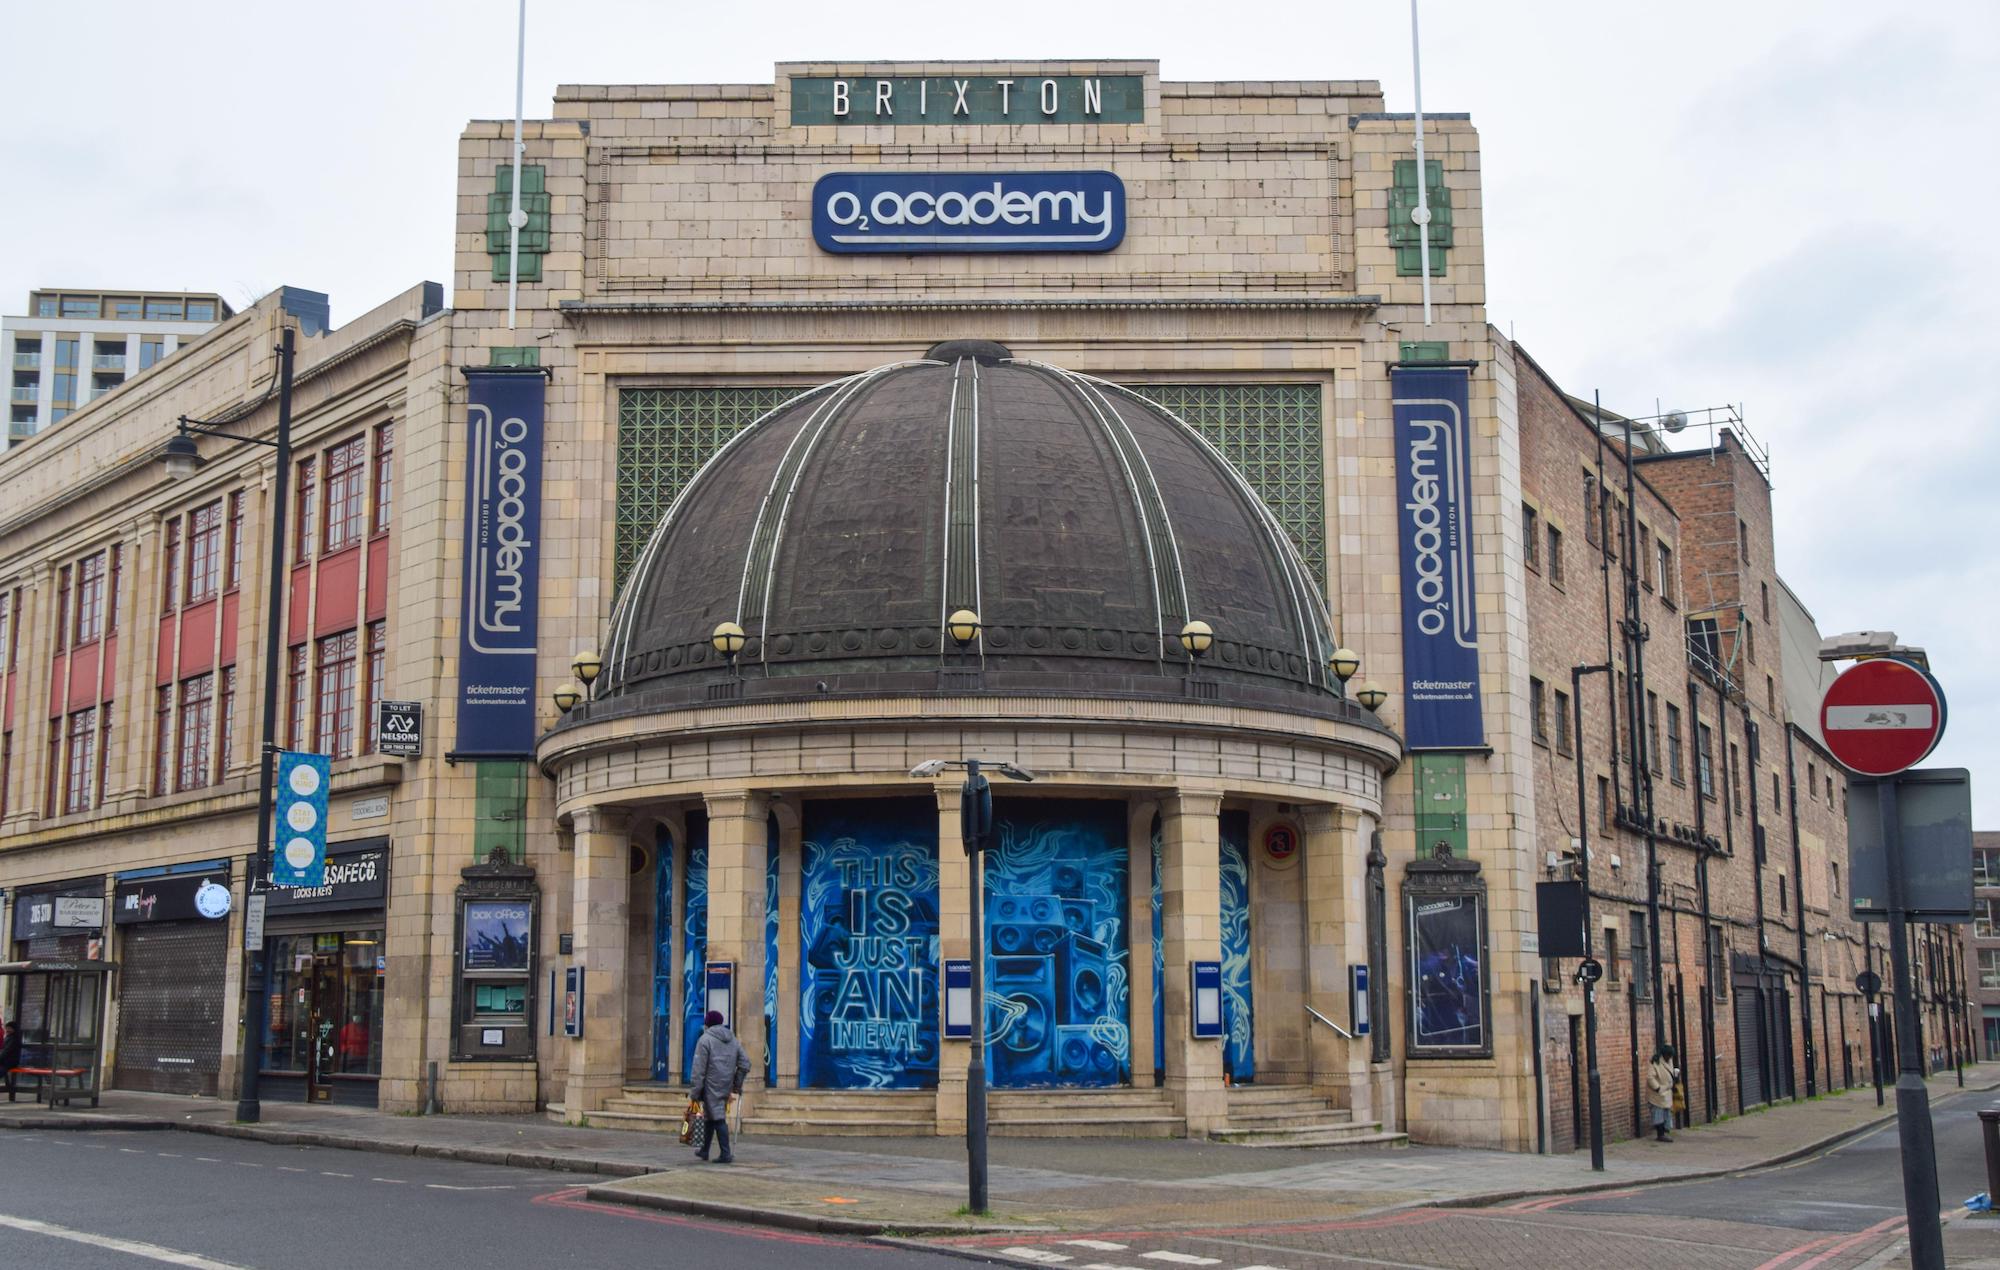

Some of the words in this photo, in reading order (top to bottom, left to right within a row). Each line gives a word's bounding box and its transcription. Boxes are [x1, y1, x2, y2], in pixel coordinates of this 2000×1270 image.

[832, 79, 1102, 116] BRIXTON
[481, 503, 489, 544] BRIXTON
[1449, 505, 1457, 547] BRIXTON
[466, 684, 527, 695] ticketmaster
[1412, 680, 1473, 690] ticketmaster
[381, 733, 419, 741] NELSONS
[834, 854, 921, 888] THIS
[125, 895, 139, 910] APE
[293, 887, 312, 899] LOCKS
[317, 885, 334, 896] KEYS
[472, 909, 491, 920] box
[495, 908, 525, 920] office
[850, 888, 914, 937] IS
[834, 936, 923, 970] JUST
[830, 969, 923, 1023] AN
[831, 1021, 923, 1050] INTERVAL
